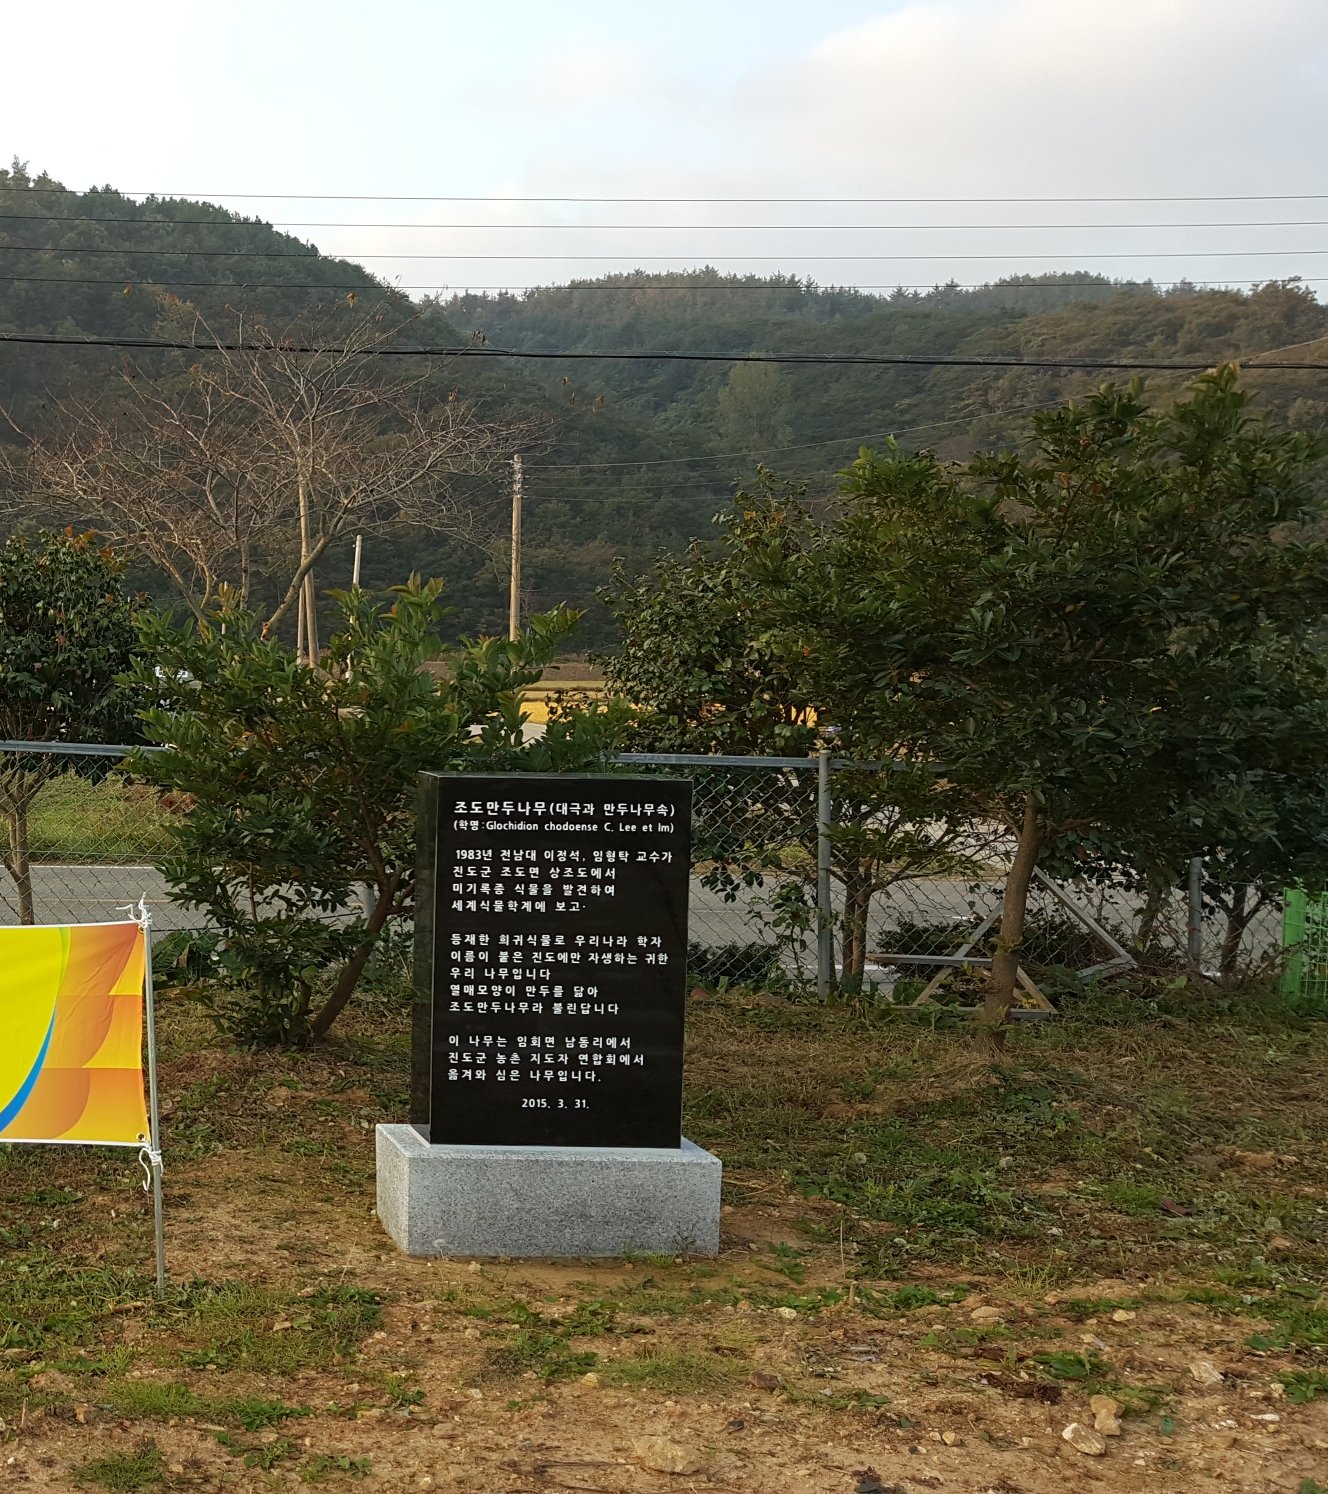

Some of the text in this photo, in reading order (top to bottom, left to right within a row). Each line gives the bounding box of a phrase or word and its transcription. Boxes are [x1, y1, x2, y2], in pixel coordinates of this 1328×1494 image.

[454, 801, 674, 816] 조도만두나무(대극과 만두나무속)
[545, 822, 598, 831] chodoense
[604, 823, 613, 831] C.
[619, 823, 636, 831] Lee
[642, 824, 652, 832] et
[658, 823, 674, 833] Im)
[456, 849, 672, 863] 1983년 전남대 이정석, 임형탁 교수가
[453, 866, 615, 879] 진도군 조도면 상조도에서
[453, 883, 614, 896] 미기록종 식물을 발견하여
[452, 900, 545, 912] 세계식물학계에
[451, 934, 661, 947] 등재한 희귀식물로 우리나라 학자
[451, 951, 668, 964] 이름이 붙은 진도에만 자생하는 귀한
[450, 967, 550, 980] 우리 나무입니다
[450, 985, 598, 997] 열매모양이 만두를 닮아
[449, 1002, 618, 1014] 조도만두나무라 불린답니다
[449, 1035, 630, 1048] 이 나무는 임회면 남동리에서
[449, 1052, 643, 1065] 진도군 농촌 지도자 연합회에서
[448, 1069, 601, 1082] 옮겨와 심은 나무입니다.
[522, 1099, 589, 1108] 2015. 3. 31.
